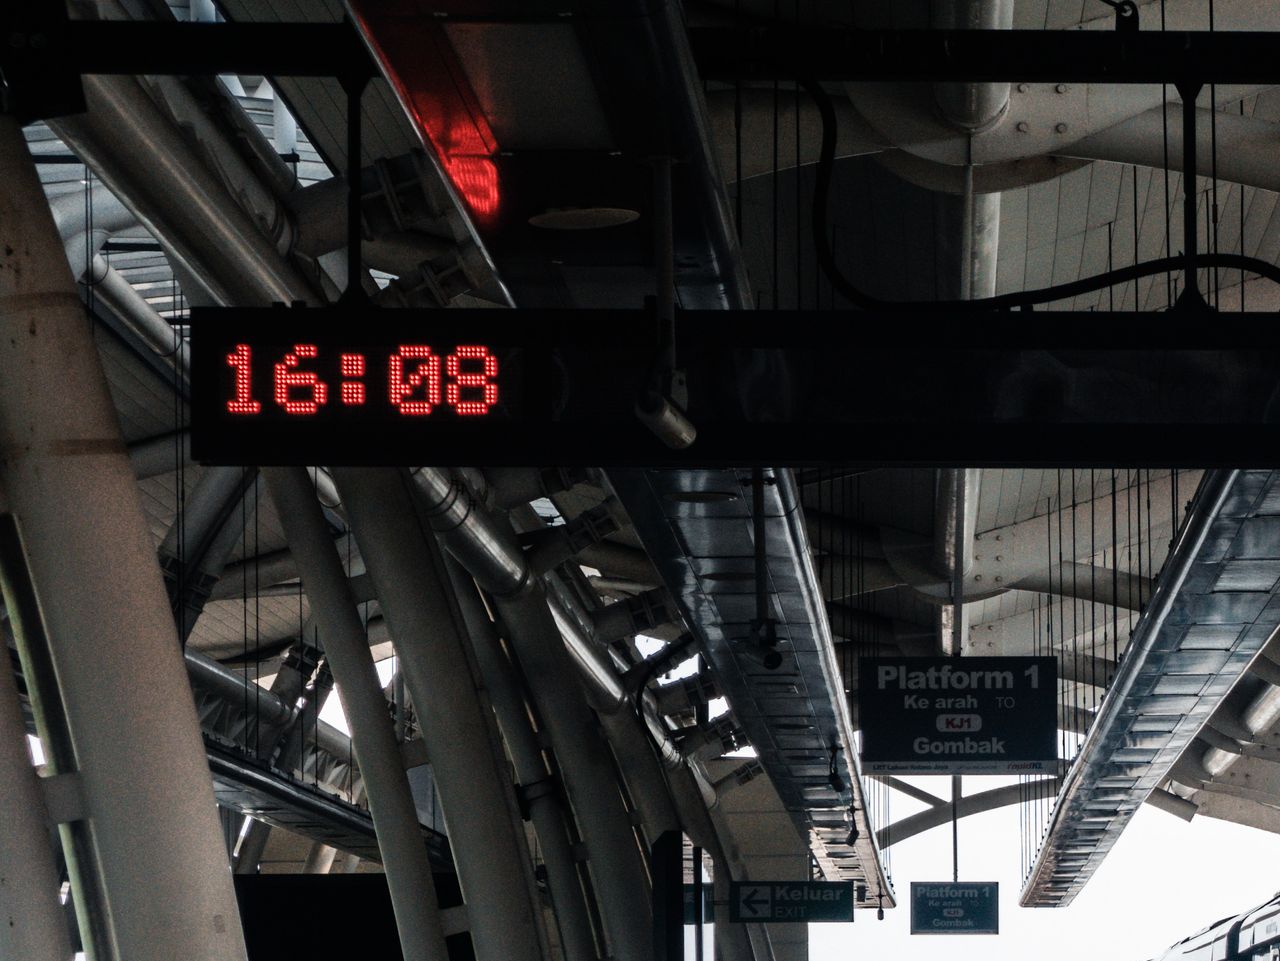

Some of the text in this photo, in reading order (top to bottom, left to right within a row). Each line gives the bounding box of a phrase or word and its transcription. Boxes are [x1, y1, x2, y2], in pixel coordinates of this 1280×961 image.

[225, 344, 499, 415] 16:08
[877, 664, 1039, 690] Platform 1
[904, 695, 1016, 710] Ke arah TO
[945, 717, 971, 729] KJ1
[913, 737, 1006, 755] Gombak
[775, 885, 844, 901] Keluar
[917, 886, 990, 898] Platform 1
[775, 906, 808, 918] EXIT
